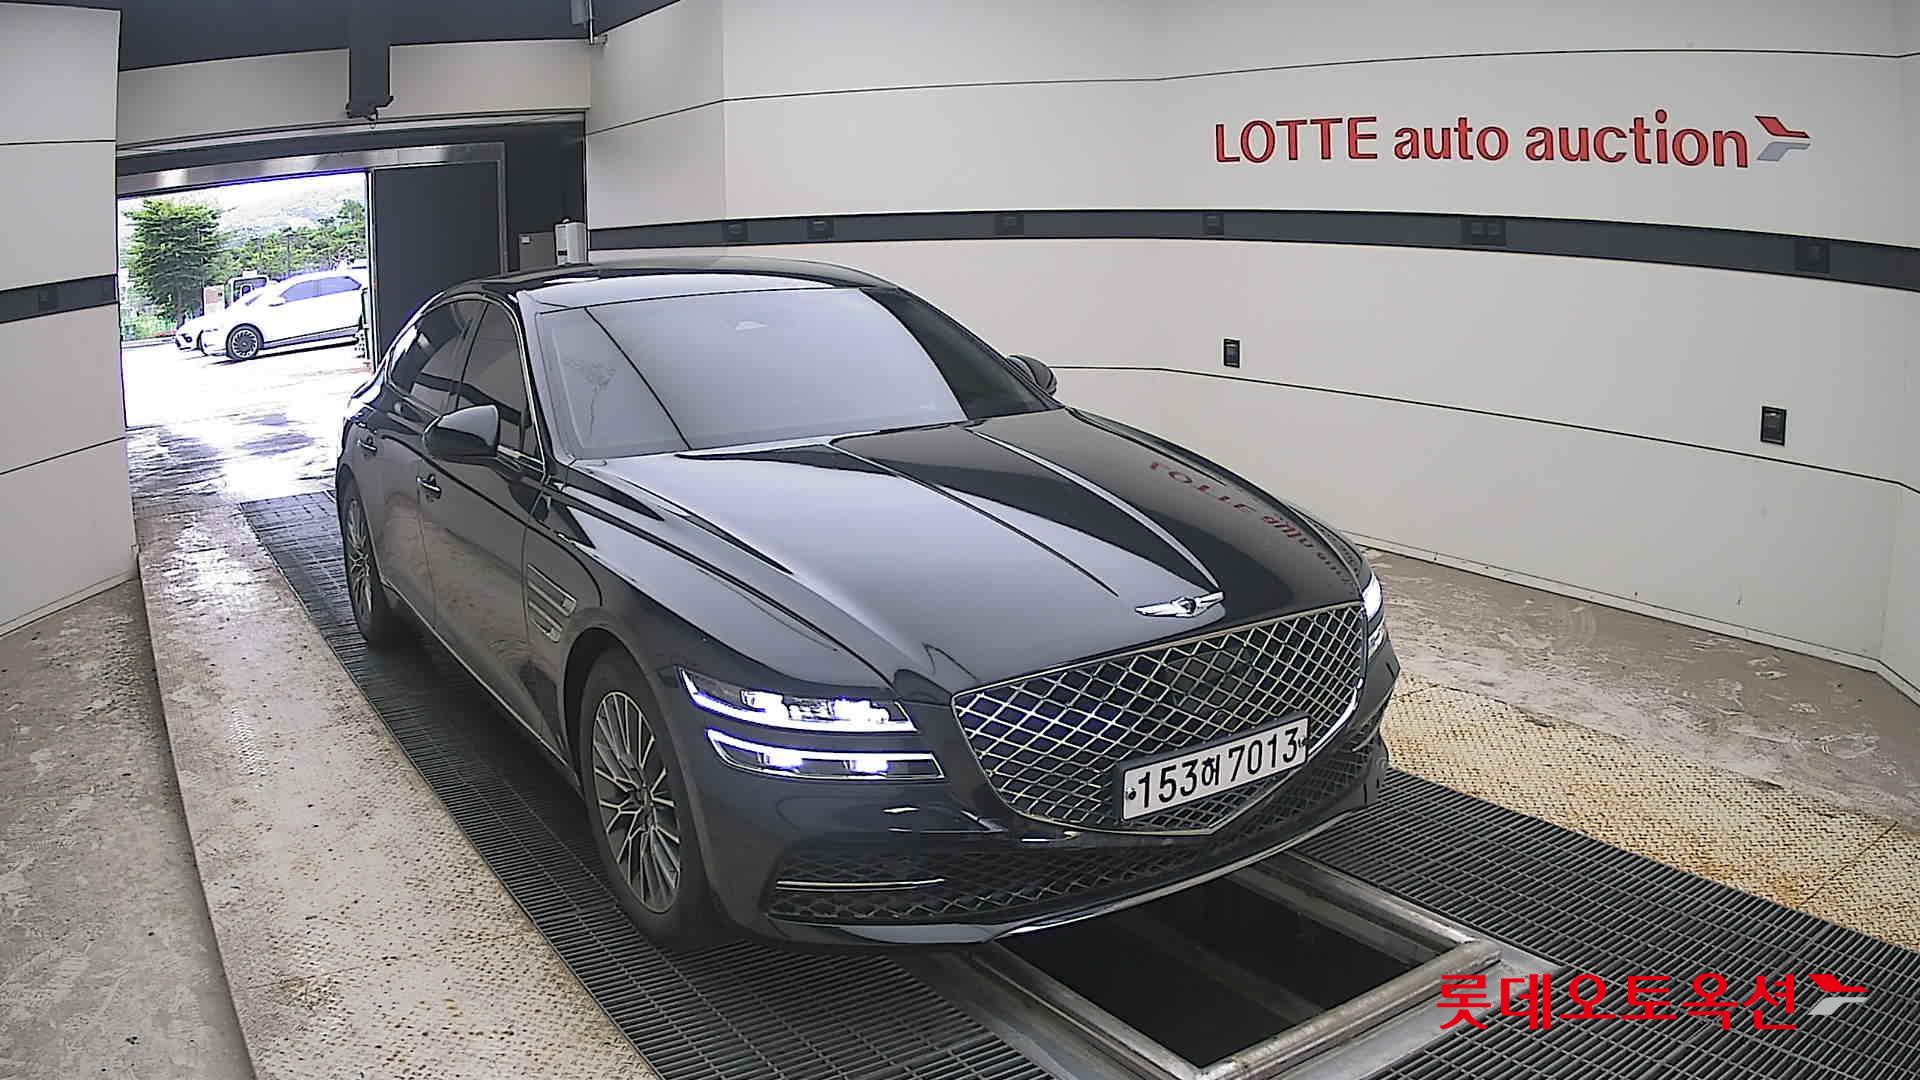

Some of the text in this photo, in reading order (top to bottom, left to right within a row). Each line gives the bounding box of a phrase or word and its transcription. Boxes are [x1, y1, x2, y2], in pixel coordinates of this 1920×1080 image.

[1214, 109, 1749, 168] LOTTE auto auction
